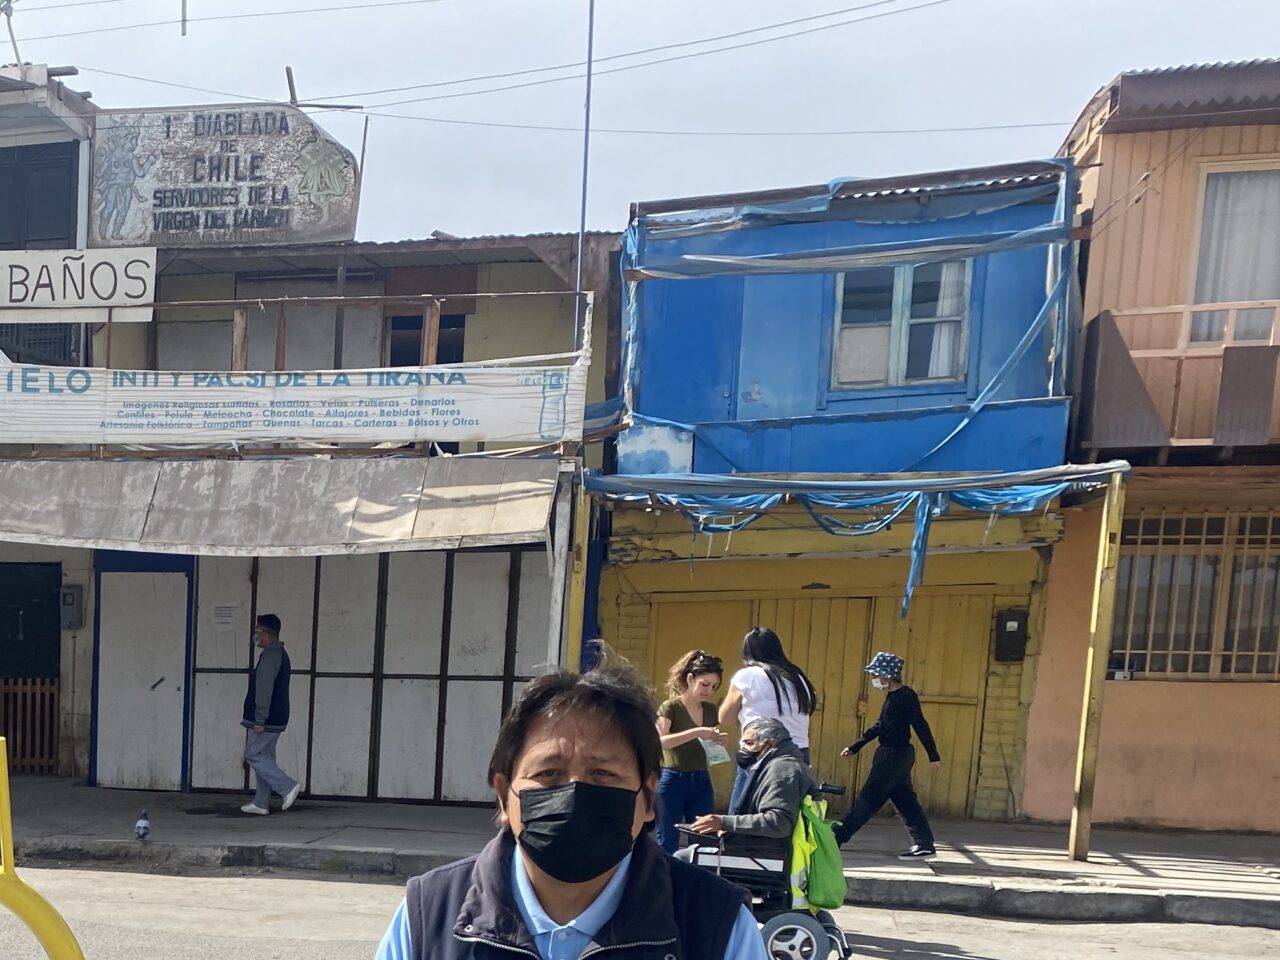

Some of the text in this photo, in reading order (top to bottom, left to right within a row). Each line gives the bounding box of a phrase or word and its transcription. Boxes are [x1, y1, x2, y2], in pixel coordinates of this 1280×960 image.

[194, 112, 290, 136] DIABLADA
[221, 139, 238, 153] DE
[192, 153, 265, 184] CHILE
[153, 184, 289, 207] SERVIDORES DE LA
[153, 210, 200, 231] VIRGEN
[8, 254, 150, 303] BAÑOS
[275, 371, 308, 388] DE
[317, 370, 351, 387] LA
[172, 400, 219, 411] Religiosas
[270, 400, 310, 408] Rosarios
[320, 399, 348, 407] Velas
[358, 399, 400, 407] Pulseras
[410, 398, 456, 407] Denarios
[203, 410, 253, 418] Melcocha
[262, 409, 314, 418] Chocolate
[325, 409, 369, 419] Alfajores
[379, 408, 421, 417] Bebidas
[431, 407, 461, 416] Flores
[262, 419, 301, 429] Quenas
[311, 419, 344, 428] Tarcas
[354, 418, 397, 427] Carteras
[408, 417, 439, 427] Bolsos
[443, 419, 450, 428] y
[452, 417, 480, 426] Otros
